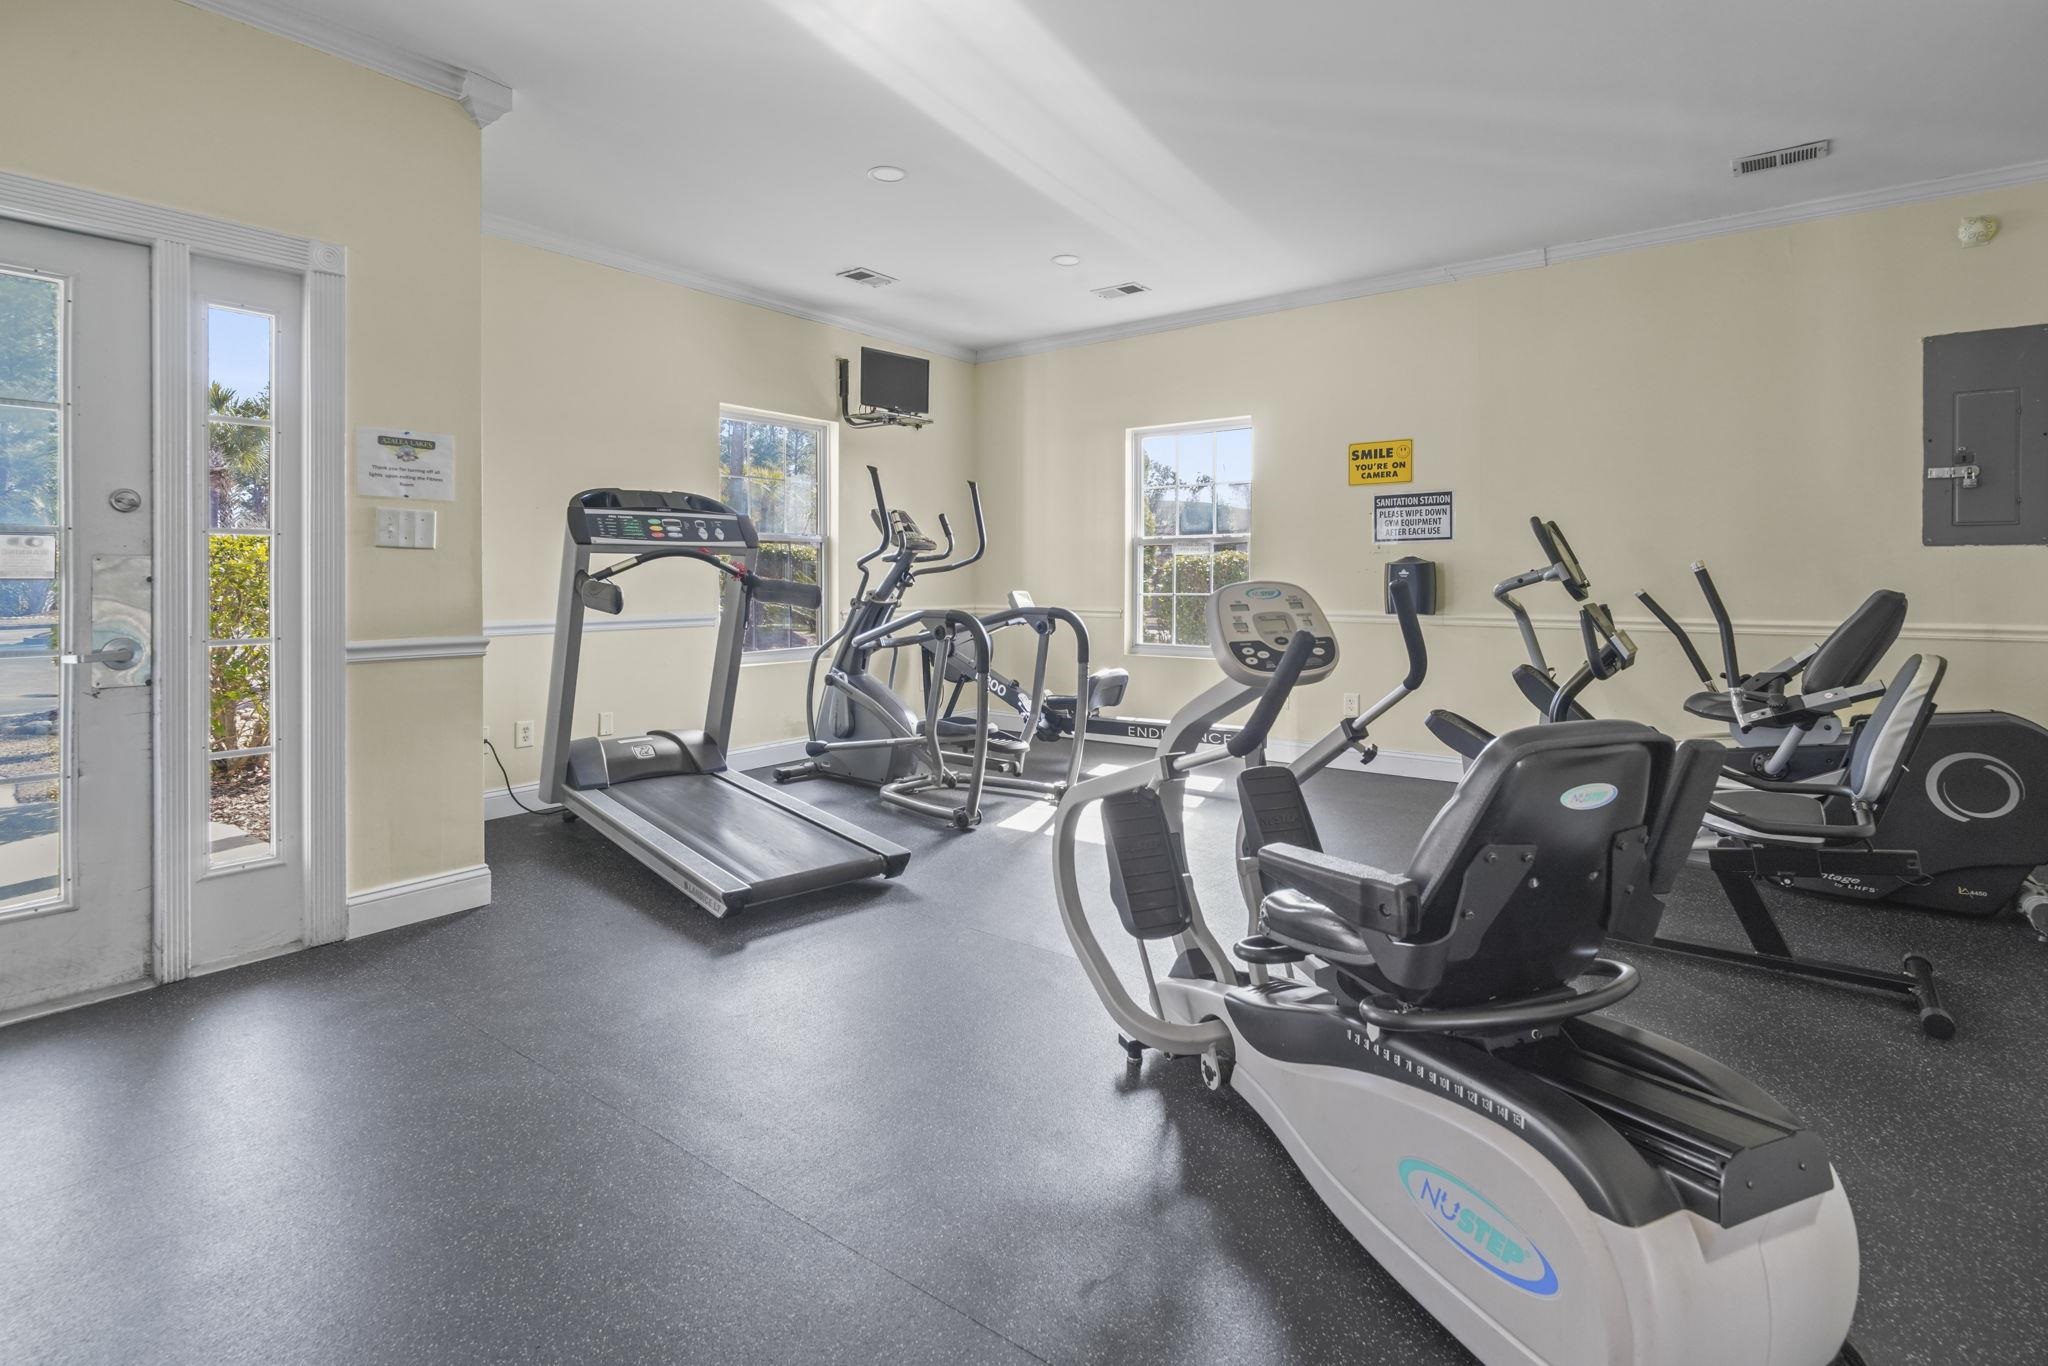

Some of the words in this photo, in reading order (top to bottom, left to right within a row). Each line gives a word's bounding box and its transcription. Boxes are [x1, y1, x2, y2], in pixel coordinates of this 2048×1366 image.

[1351, 447, 1394, 461] SMILE
[1355, 462, 1388, 471] YOU'RE
[1392, 461, 1406, 469] ON
[1361, 470, 1399, 479] CAMERA
[1376, 496, 1419, 508] SANITATION
[1420, 494, 1451, 505] STATION
[1379, 509, 1405, 519] PLEASE
[1405, 508, 1423, 517] WIPE
[1424, 507, 1447, 516] DOWN
[1384, 518, 1400, 527] GYM
[1401, 517, 1442, 527] EQUIPMENT
[1385, 527, 1407, 537] AFTER
[1408, 527, 1426, 536] EACH
[1427, 526, 1441, 535] USE
